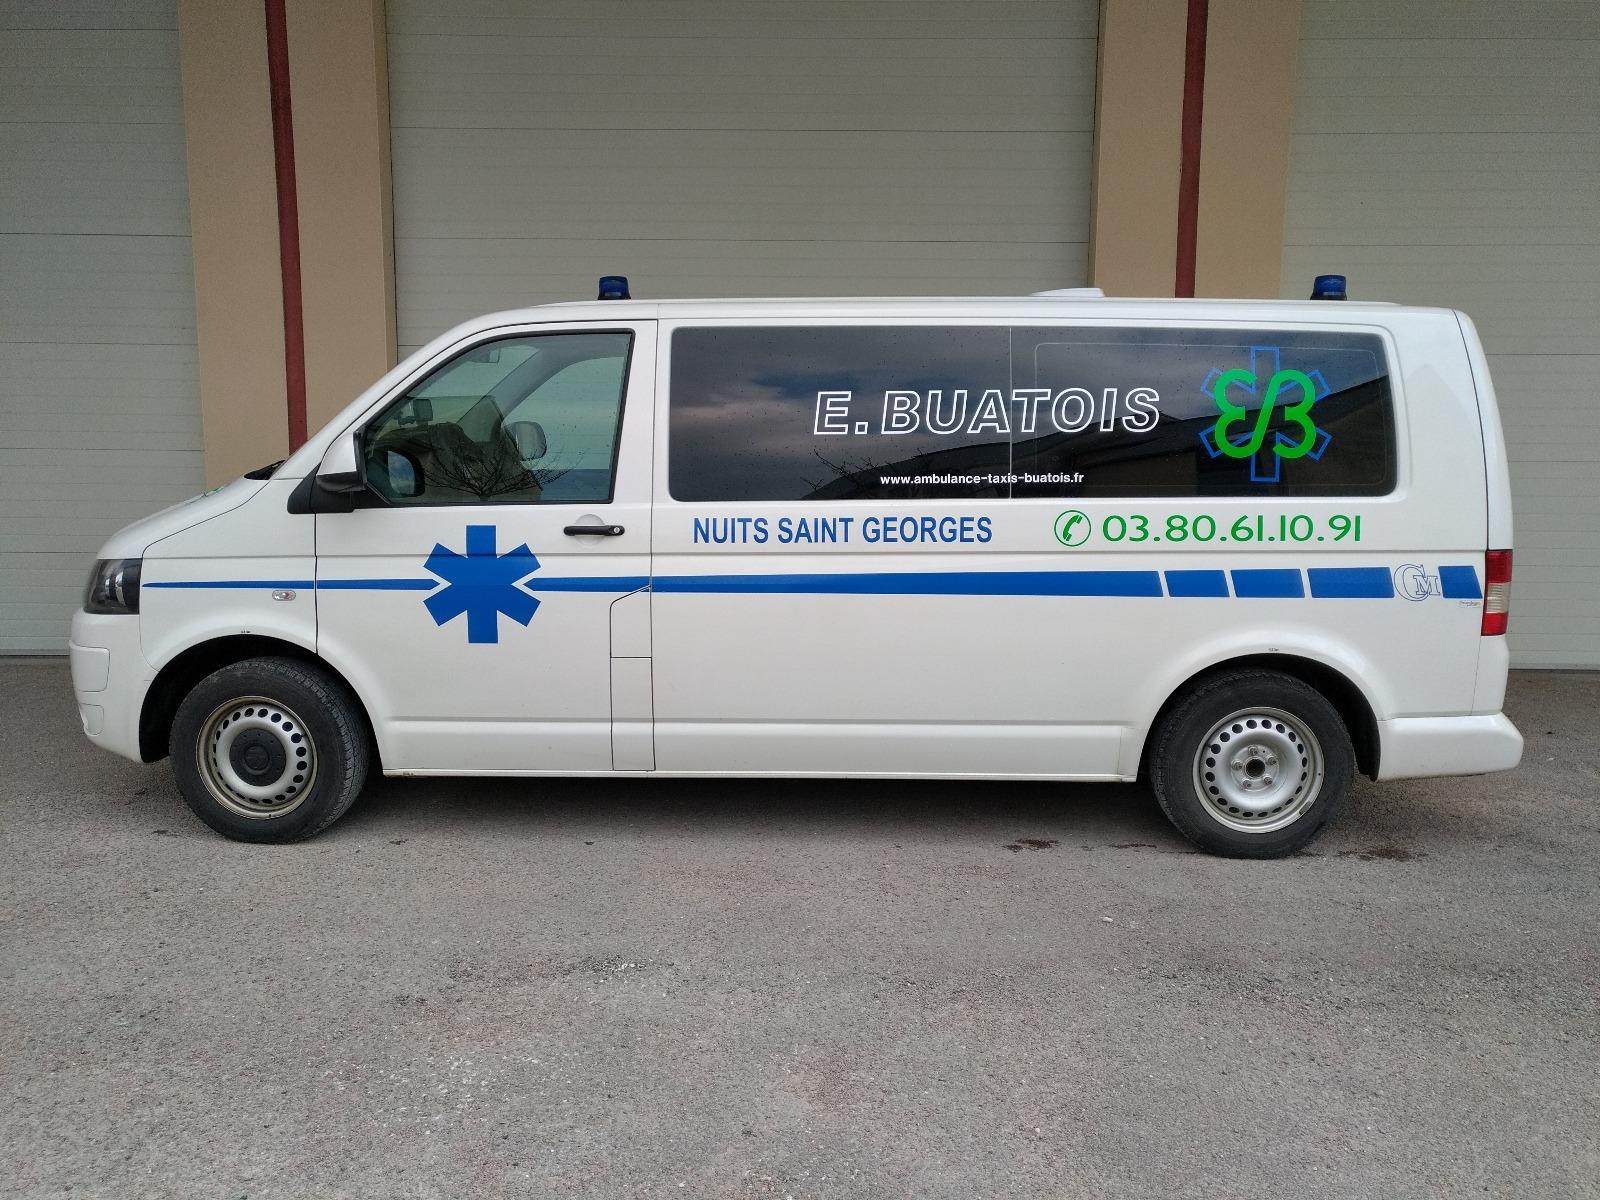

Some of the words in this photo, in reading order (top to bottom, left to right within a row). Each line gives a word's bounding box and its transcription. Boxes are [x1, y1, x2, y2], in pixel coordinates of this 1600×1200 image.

[814, 390, 869, 435] E.
[881, 387, 1161, 434] BUATOIS
[880, 472, 1085, 485] www.ambulance-taxis-buatois.fr
[693, 517, 769, 544] NUITS
[777, 517, 855, 543] SAINT
[862, 516, 993, 543] GEORGES
[1102, 514, 1362, 542] 03.80.61.10.91
